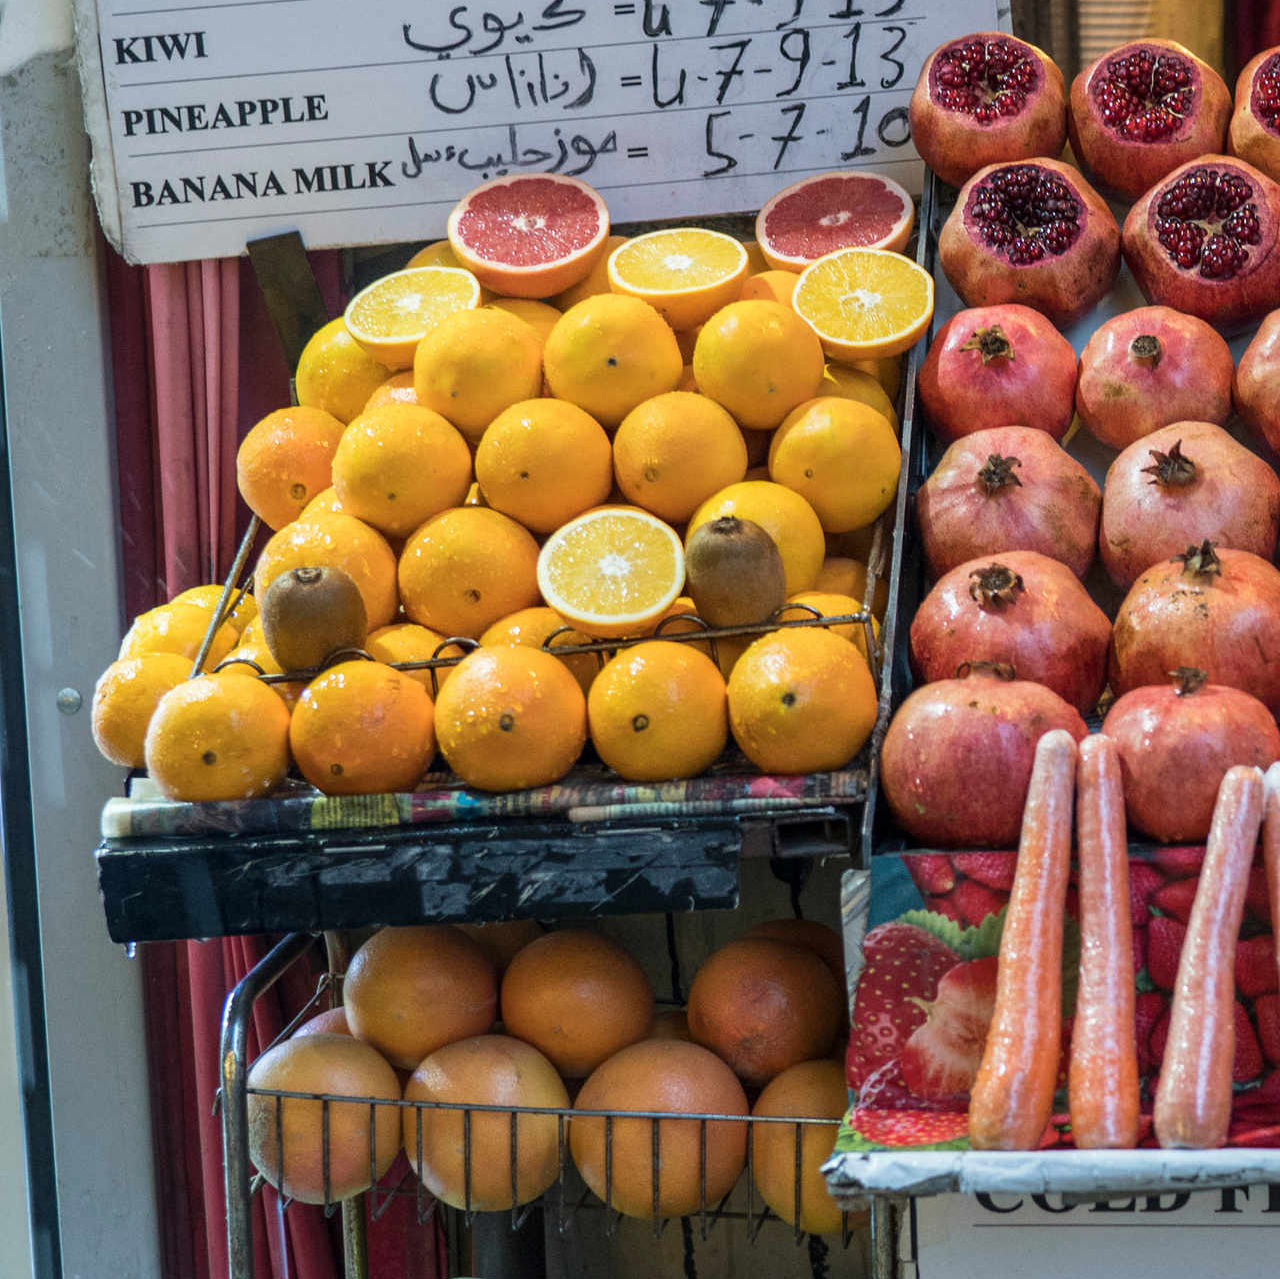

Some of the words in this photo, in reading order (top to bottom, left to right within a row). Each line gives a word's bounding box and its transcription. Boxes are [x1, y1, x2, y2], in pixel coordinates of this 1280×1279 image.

[113, 31, 209, 66] KIWI
[121, 94, 330, 137] PINEAPPLE
[131, 166, 287, 208] BANANA
[293, 160, 396, 196] MILK
